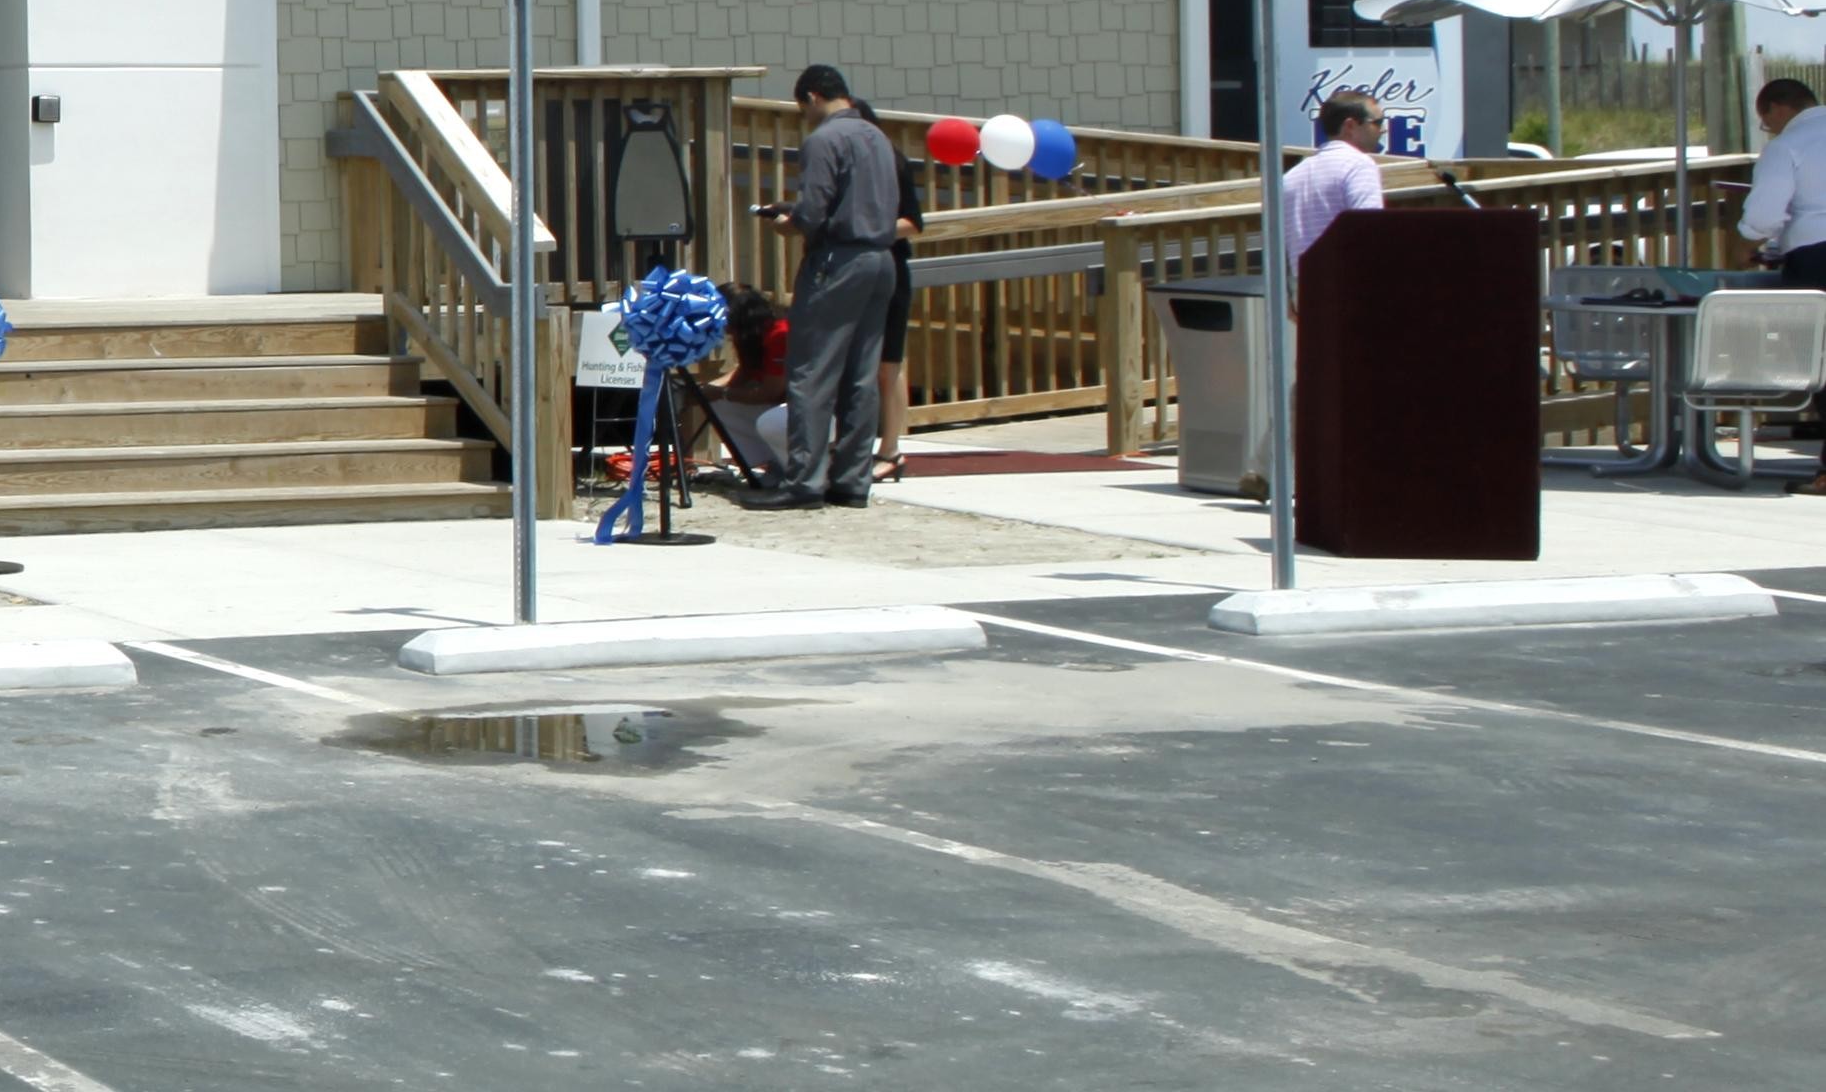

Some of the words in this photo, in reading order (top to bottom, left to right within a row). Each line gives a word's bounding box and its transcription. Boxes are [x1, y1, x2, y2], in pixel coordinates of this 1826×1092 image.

[582, 361, 616, 374] Hunting
[618, 362, 624, 372] &
[601, 373, 636, 385] Licenses
